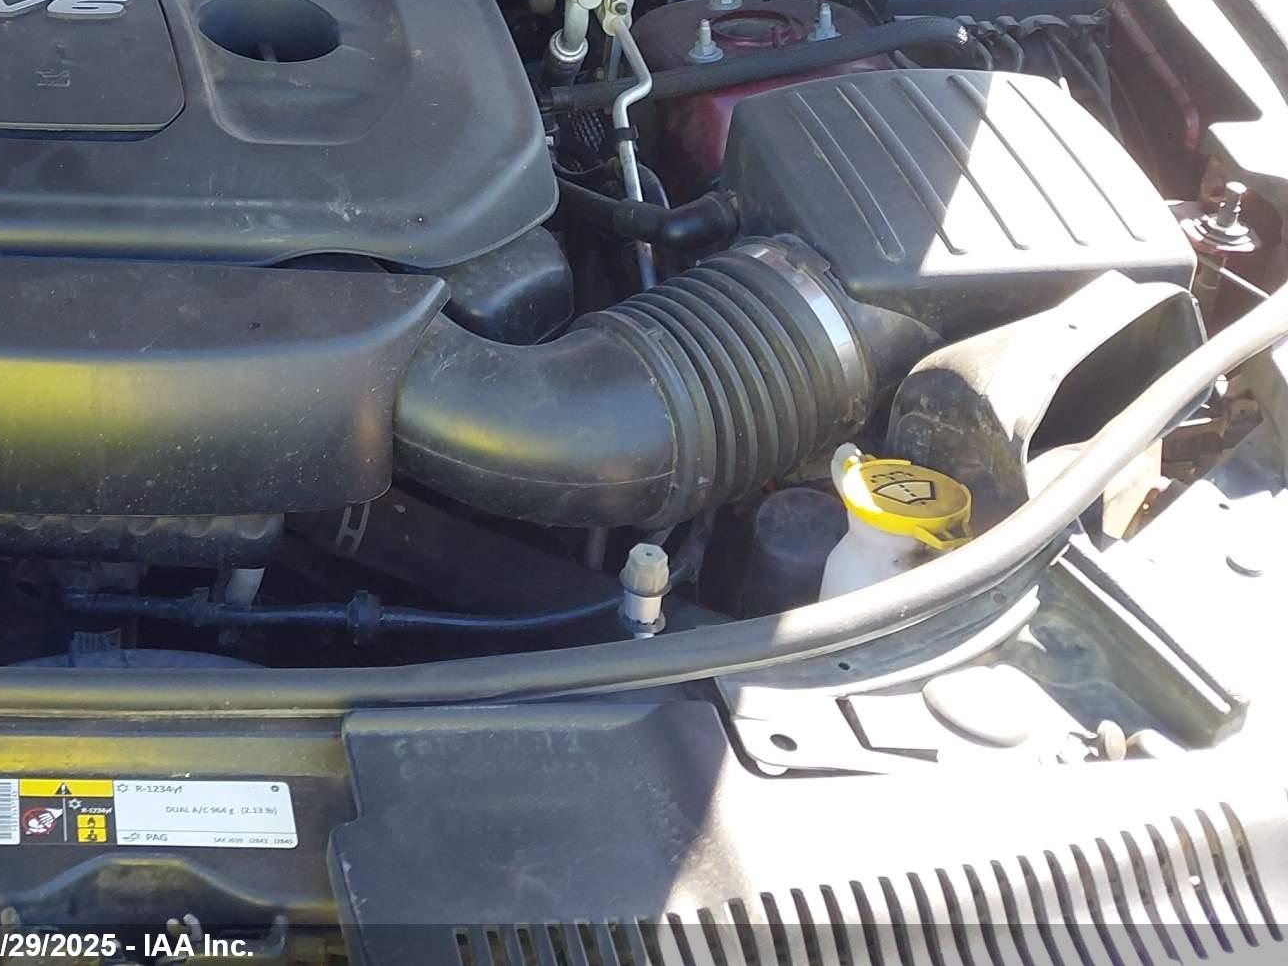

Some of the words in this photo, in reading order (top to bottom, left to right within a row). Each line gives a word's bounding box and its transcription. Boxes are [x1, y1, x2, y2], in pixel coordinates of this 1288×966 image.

[135, 785, 183, 794] R-1234yf
[165, 806, 192, 814] DUAL
[192, 806, 209, 815] A/C
[146, 834, 168, 842] PAG
